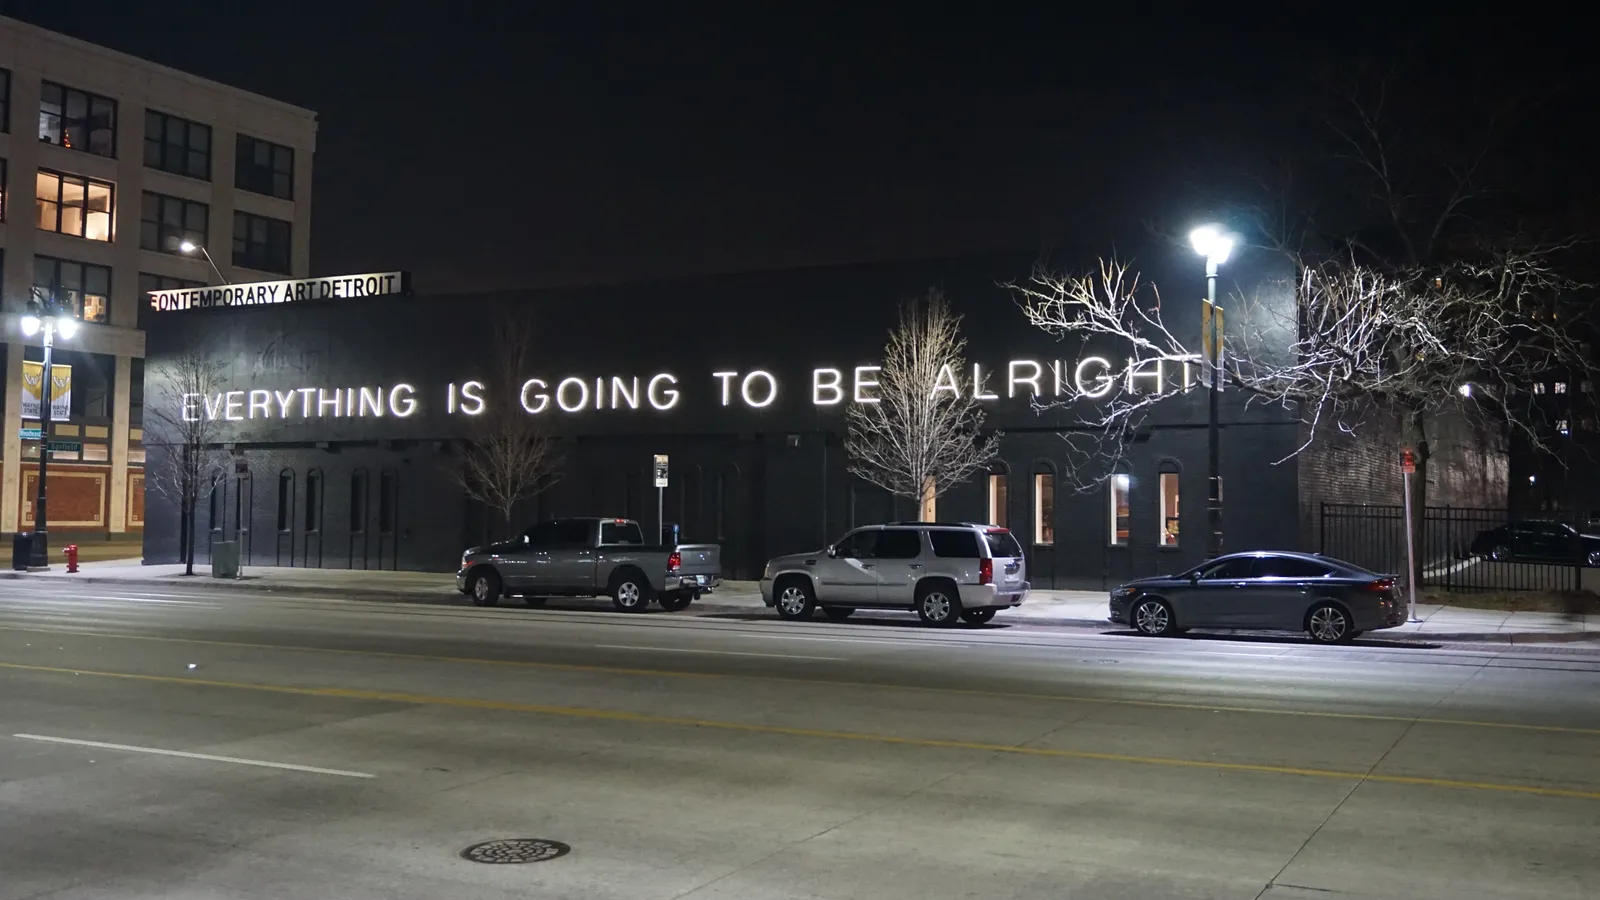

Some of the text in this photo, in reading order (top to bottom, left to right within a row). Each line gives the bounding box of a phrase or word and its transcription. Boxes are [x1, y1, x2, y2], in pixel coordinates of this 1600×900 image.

[284, 280, 317, 302] ART
[320, 274, 396, 299] DETROIT
[182, 354, 1202, 422] EVERYTHING IS GOING TO BE ALRIGHT
